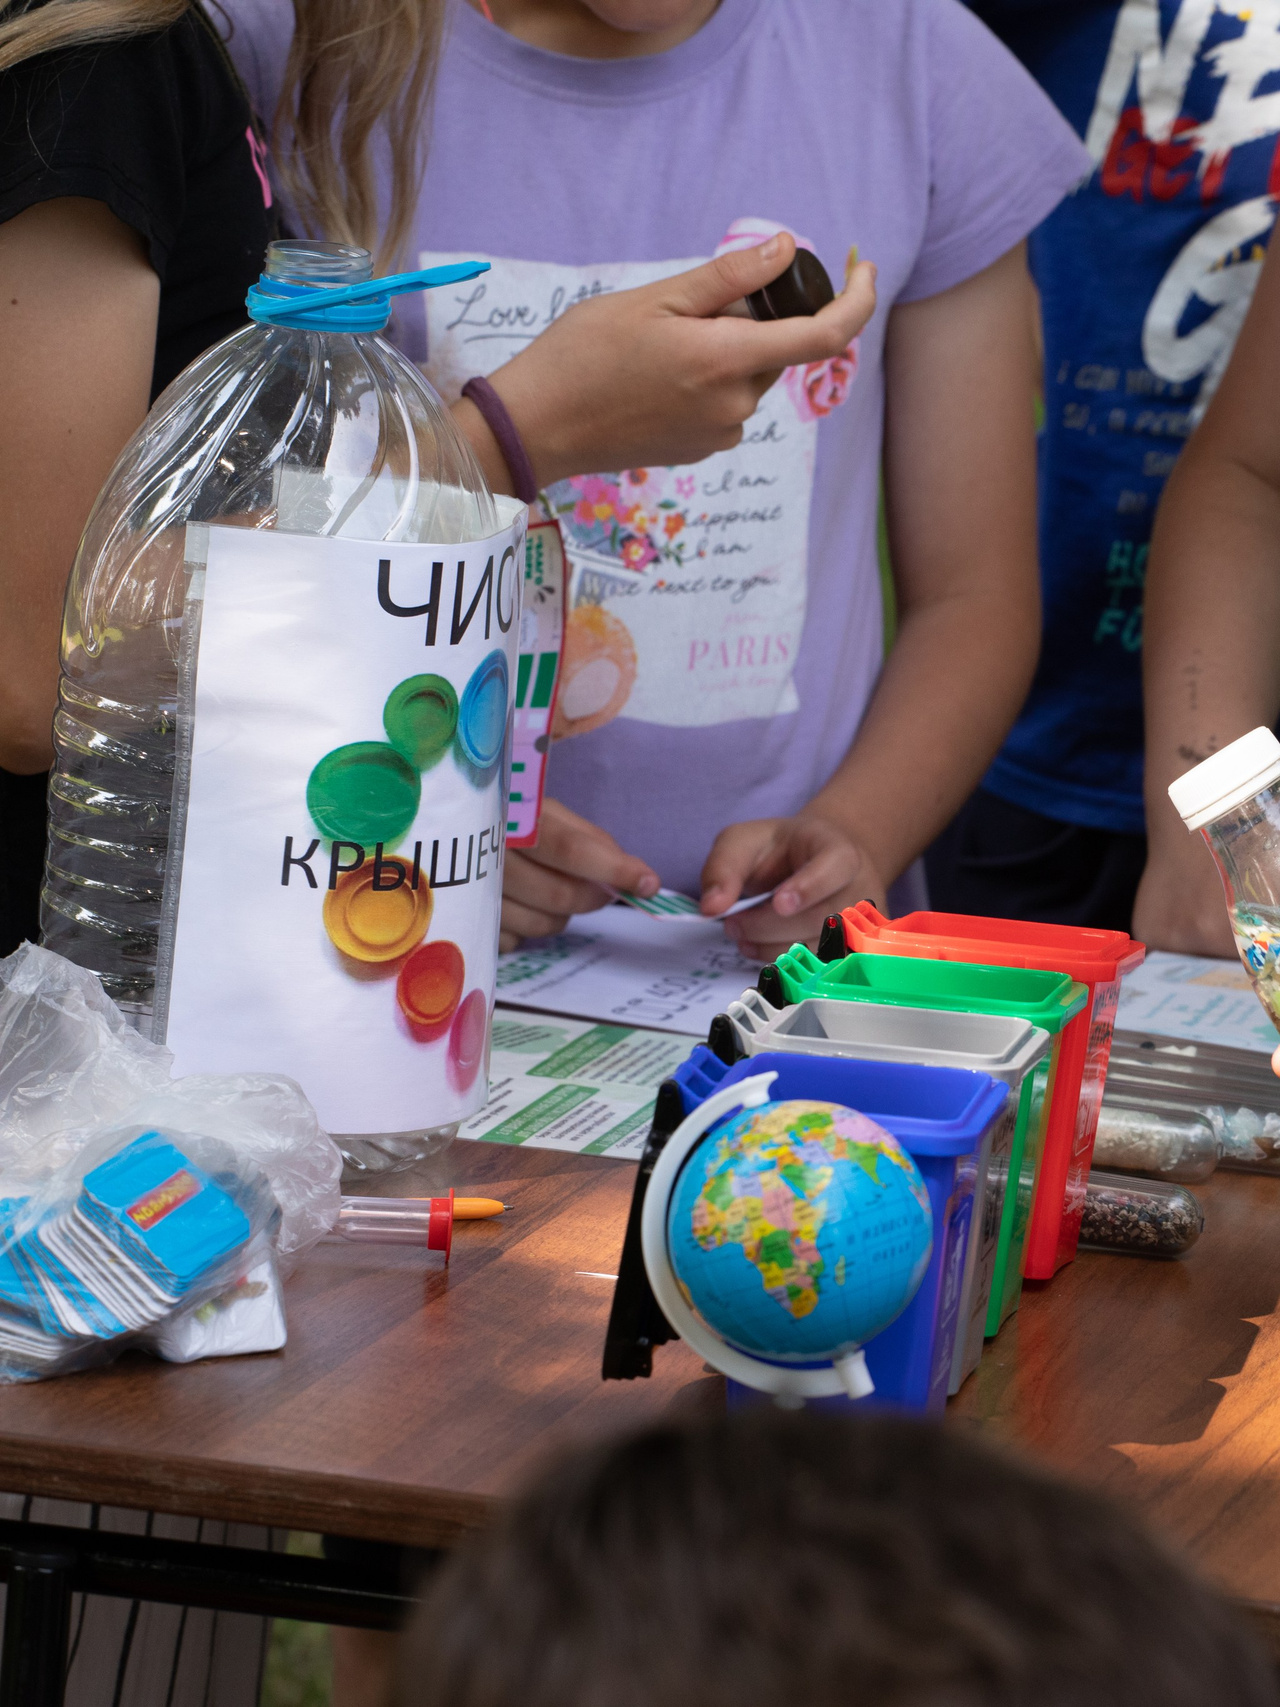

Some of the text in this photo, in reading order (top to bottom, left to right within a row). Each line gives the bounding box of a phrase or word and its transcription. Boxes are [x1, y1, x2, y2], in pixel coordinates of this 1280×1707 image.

[446, 284, 538, 331] Love
[687, 632, 792, 672] PARIS
[281, 820, 504, 891] КРЫШЕЧ
